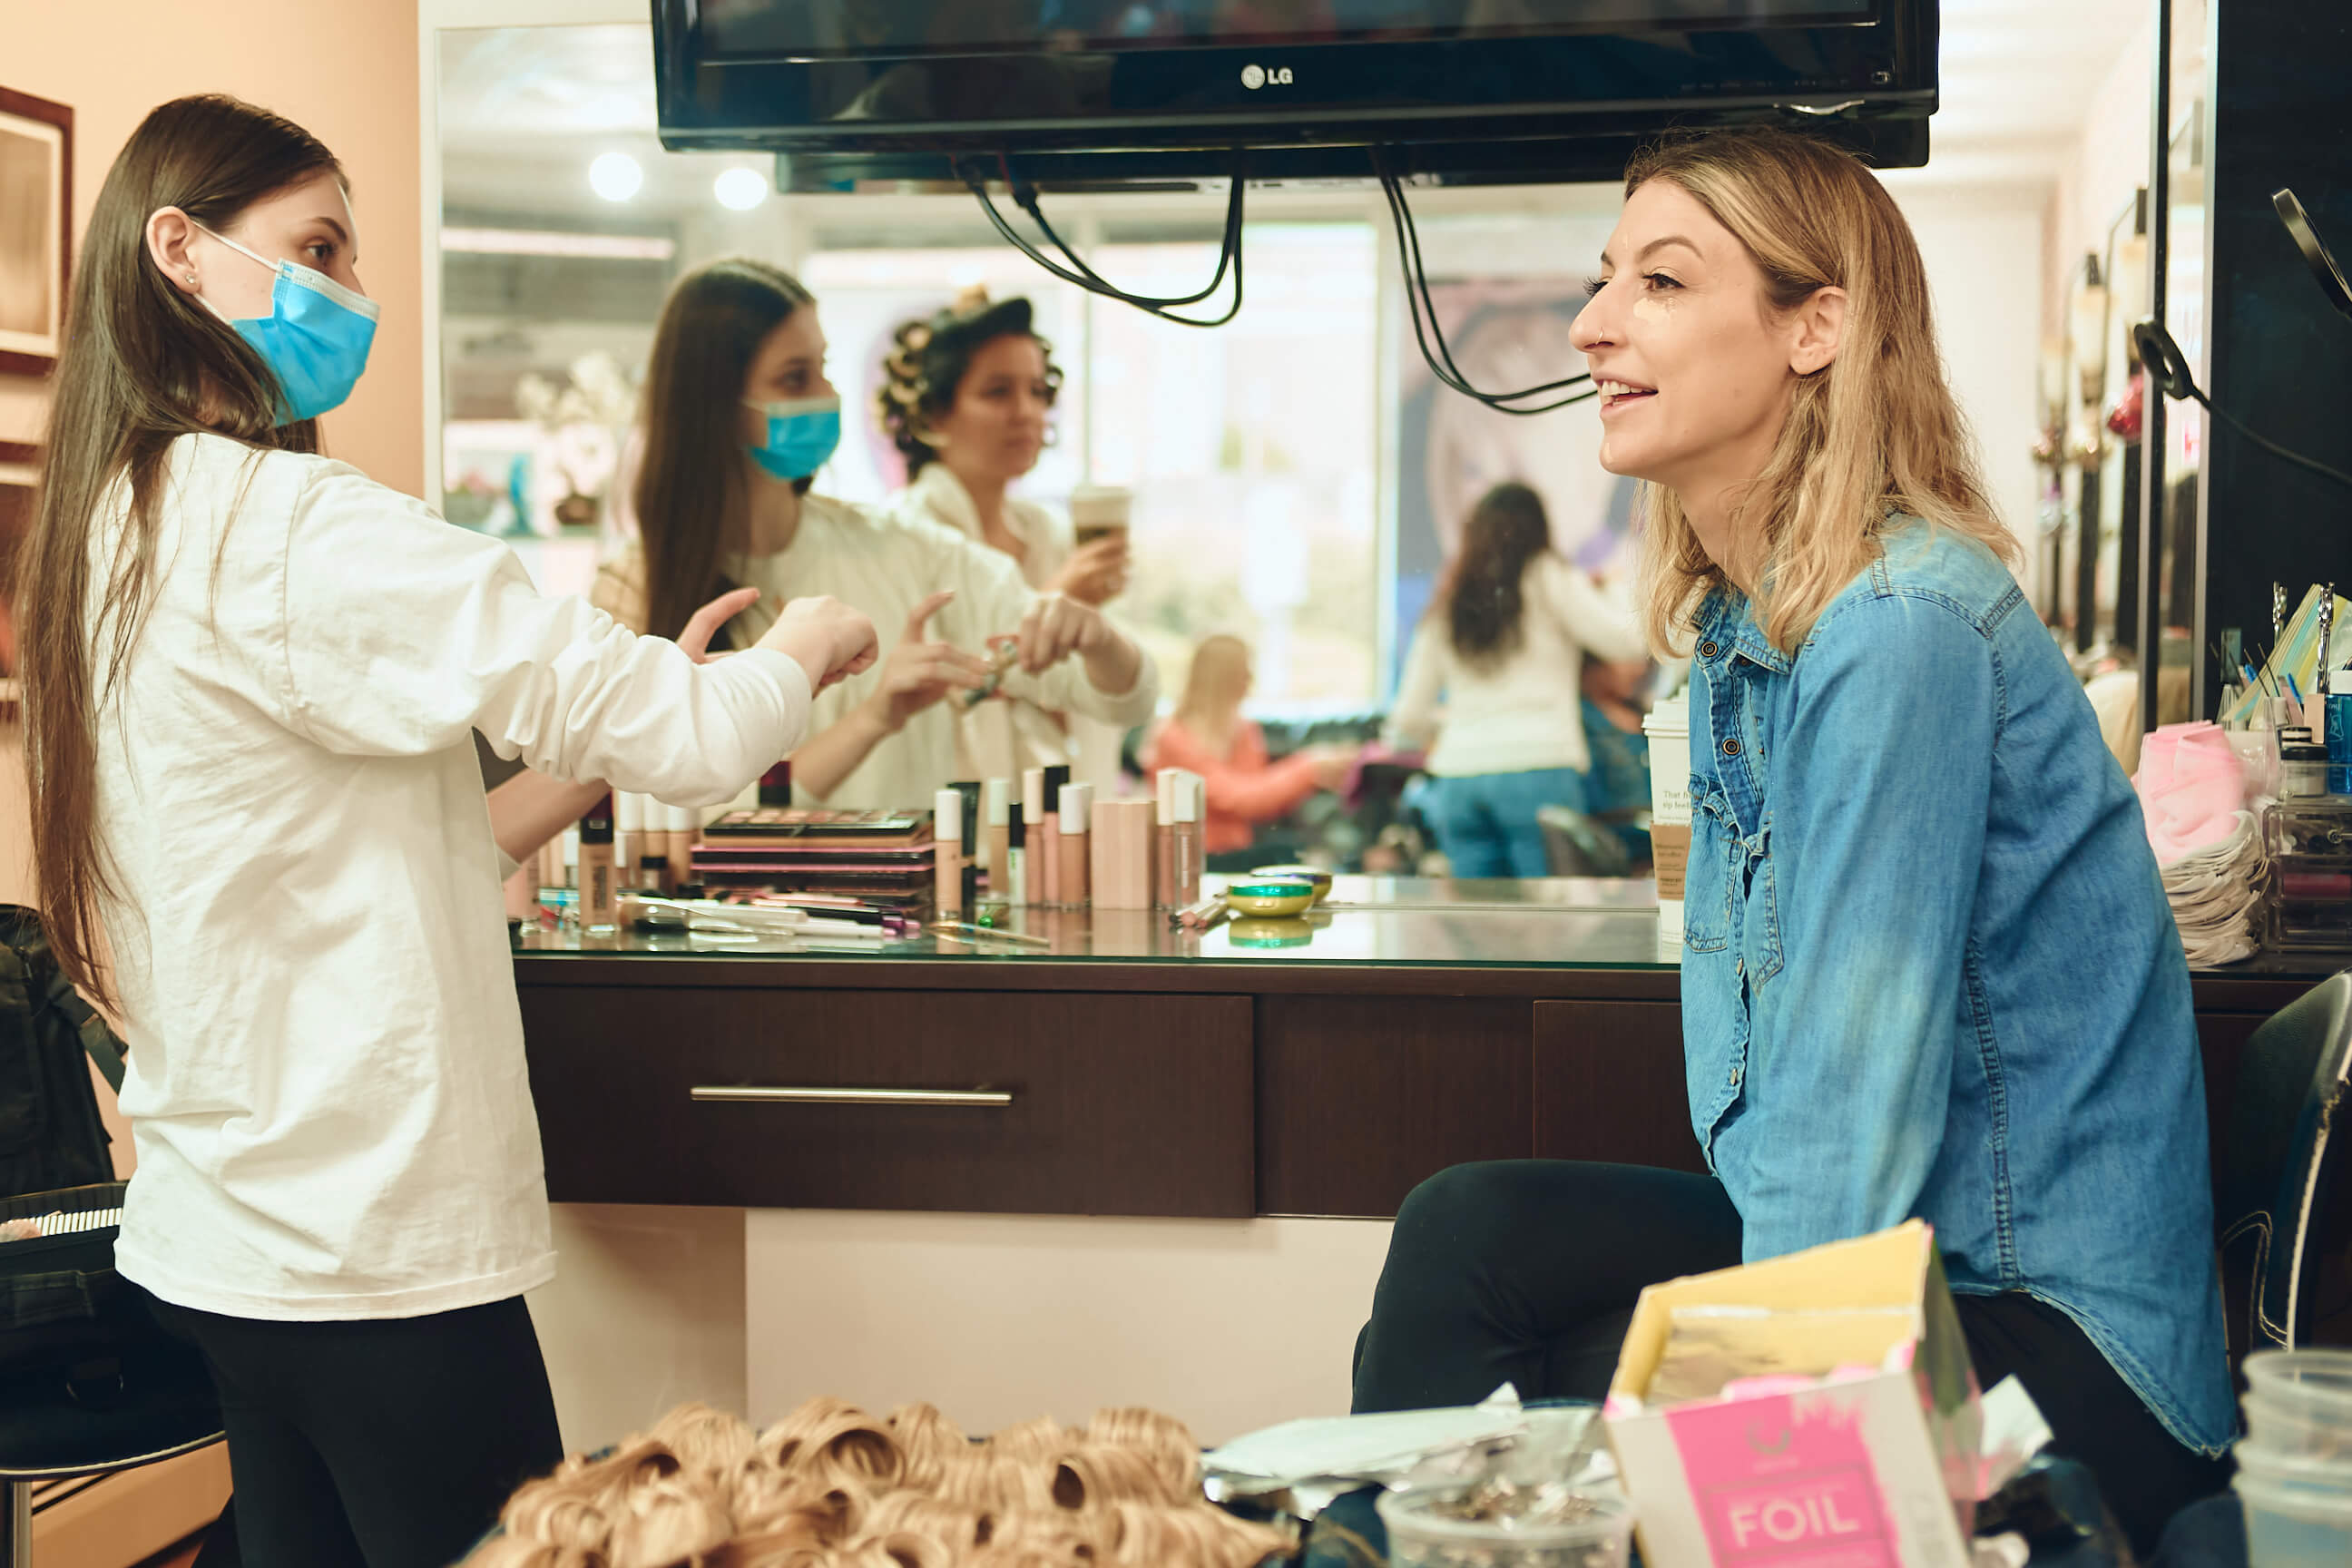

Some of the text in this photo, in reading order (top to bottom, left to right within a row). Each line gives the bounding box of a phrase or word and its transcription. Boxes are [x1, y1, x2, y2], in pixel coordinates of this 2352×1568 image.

[1267, 67, 1293, 84] LG
[1662, 790, 1681, 799] That
[1729, 1495, 1858, 1547] FOIL
